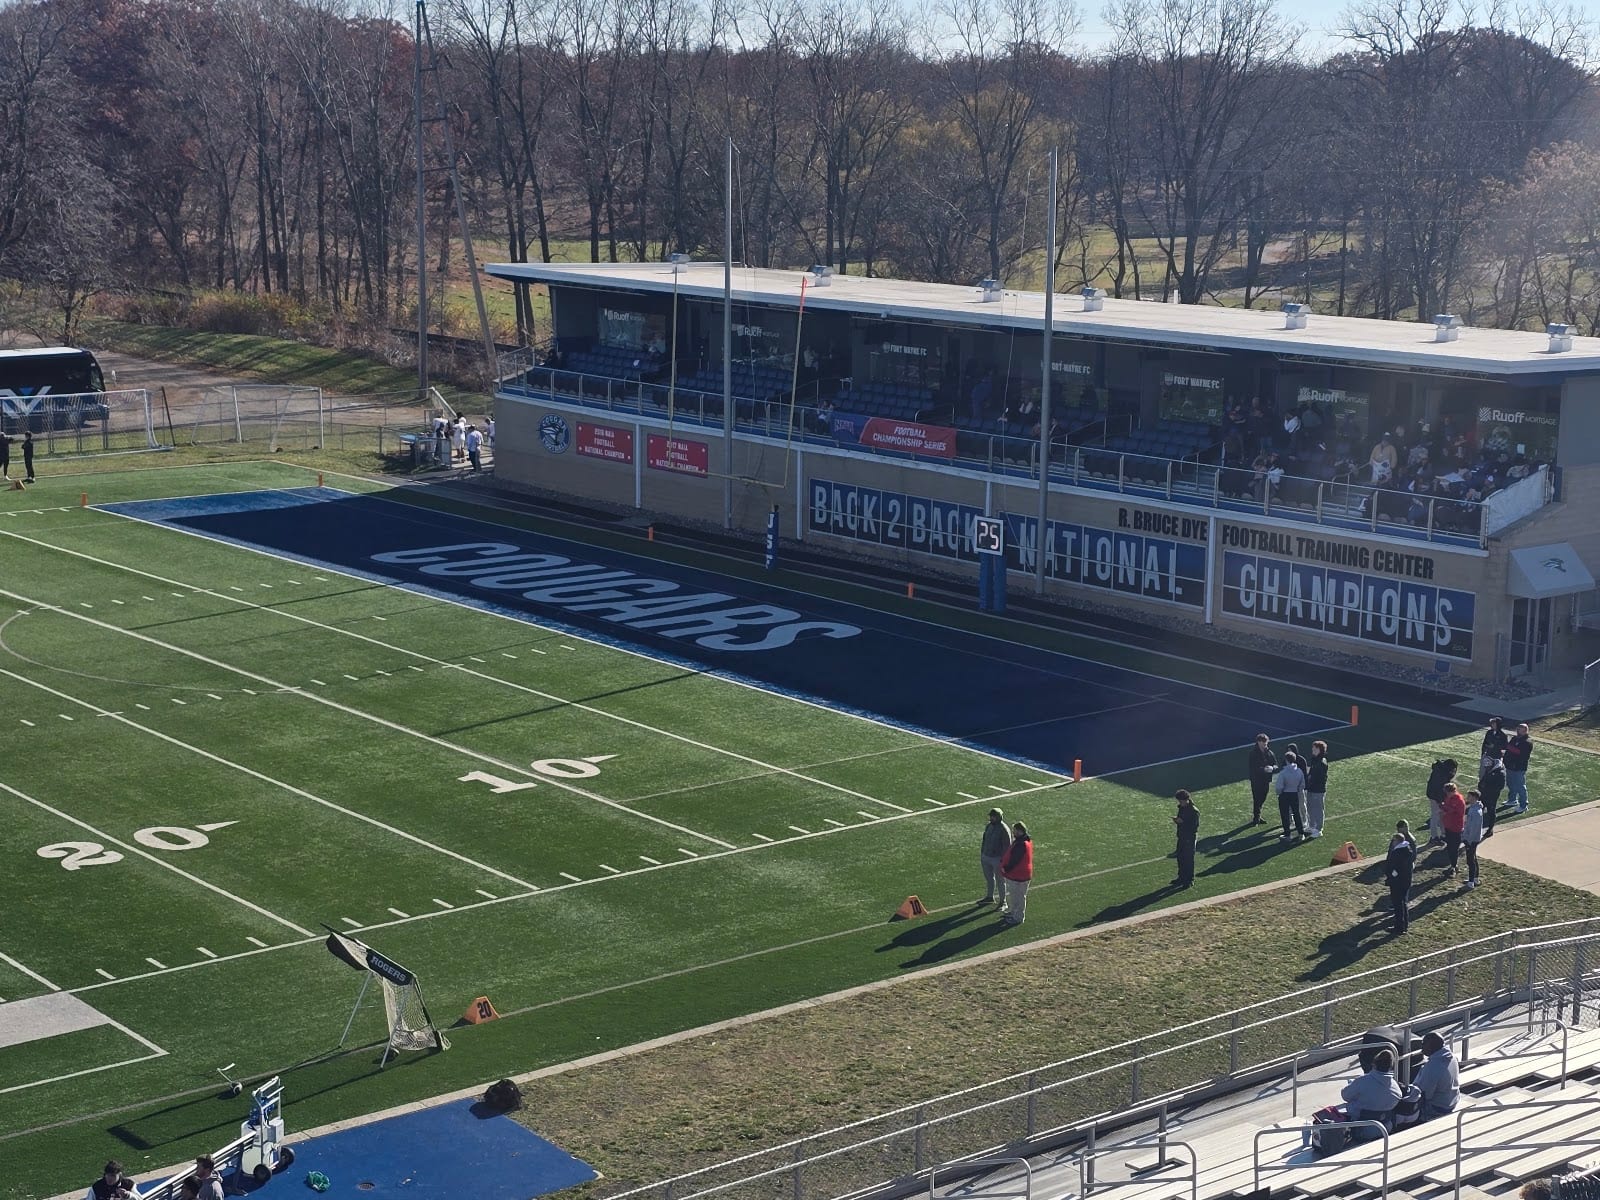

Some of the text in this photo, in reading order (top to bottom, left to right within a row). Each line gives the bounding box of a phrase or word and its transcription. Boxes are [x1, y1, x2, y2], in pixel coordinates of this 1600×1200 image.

[1051, 362, 1062, 372] ORT
[1173, 375, 1190, 386] FORT
[1211, 379, 1220, 390] FC
[1311, 389, 1339, 403] Ruoff
[1492, 409, 1557, 426] Ruoff MORTGAGE
[872, 432, 947, 451] CHAMPIONSHIP SERIES
[894, 426, 927, 439] FOOTBALL
[666, 450, 688, 461] FOTBALL
[979, 522, 999, 549] 25
[1118, 507, 1434, 580] R. BRUCE DYE FOOTBALL TRAINING CENTER
[814, 485, 1453, 646] BACK 2 BACK NATIONAL CHAMPIONS
[370, 542, 863, 652] COUGARS
[457, 757, 602, 794] 10
[36, 826, 210, 871] 20
[1347, 845, 1358, 860] G
[909, 899, 922, 915] 10
[371, 955, 407, 982] ROGERS
[477, 1000, 492, 1019] 20
